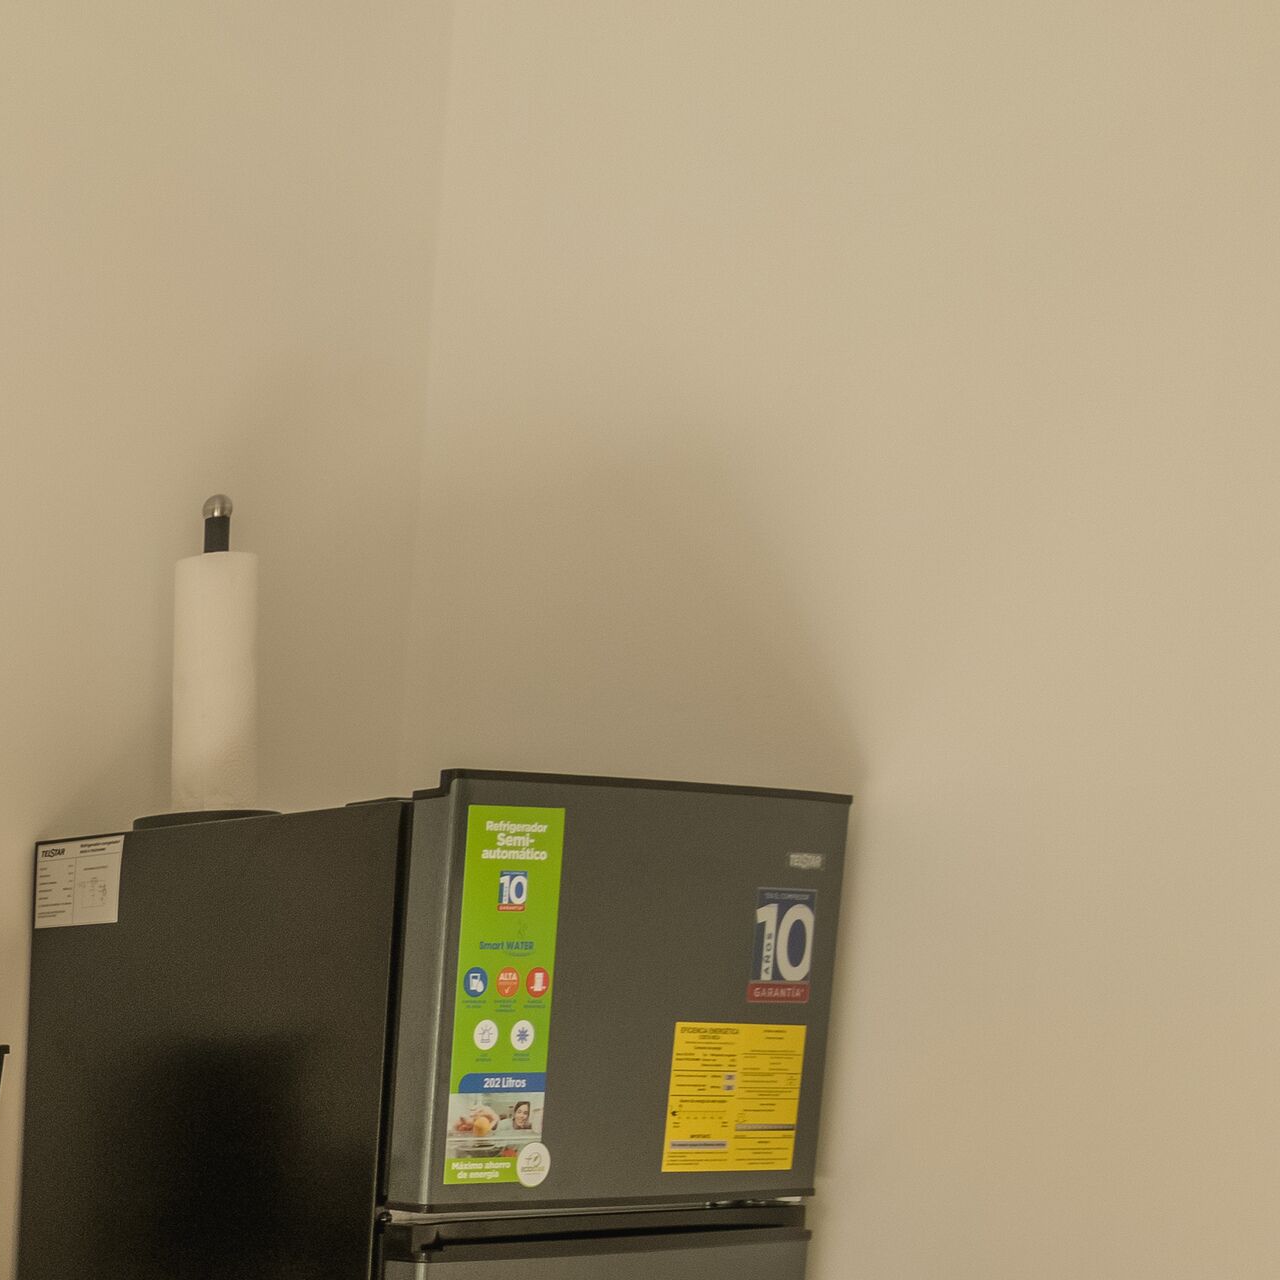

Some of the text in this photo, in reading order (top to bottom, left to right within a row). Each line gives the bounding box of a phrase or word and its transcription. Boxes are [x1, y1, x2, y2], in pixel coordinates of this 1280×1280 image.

[485, 820, 548, 833] Refrigerador
[496, 833, 535, 847] Semi-
[41, 848, 66, 858] TELSTAR
[481, 847, 548, 861] automático
[499, 875, 528, 905] 10
[756, 903, 814, 981] 10
[499, 972, 518, 981] ALTA
[502, 1076, 527, 1088] Litros
[451, 1161, 511, 1170] Máximo ahorro
[457, 1171, 467, 1179] de
